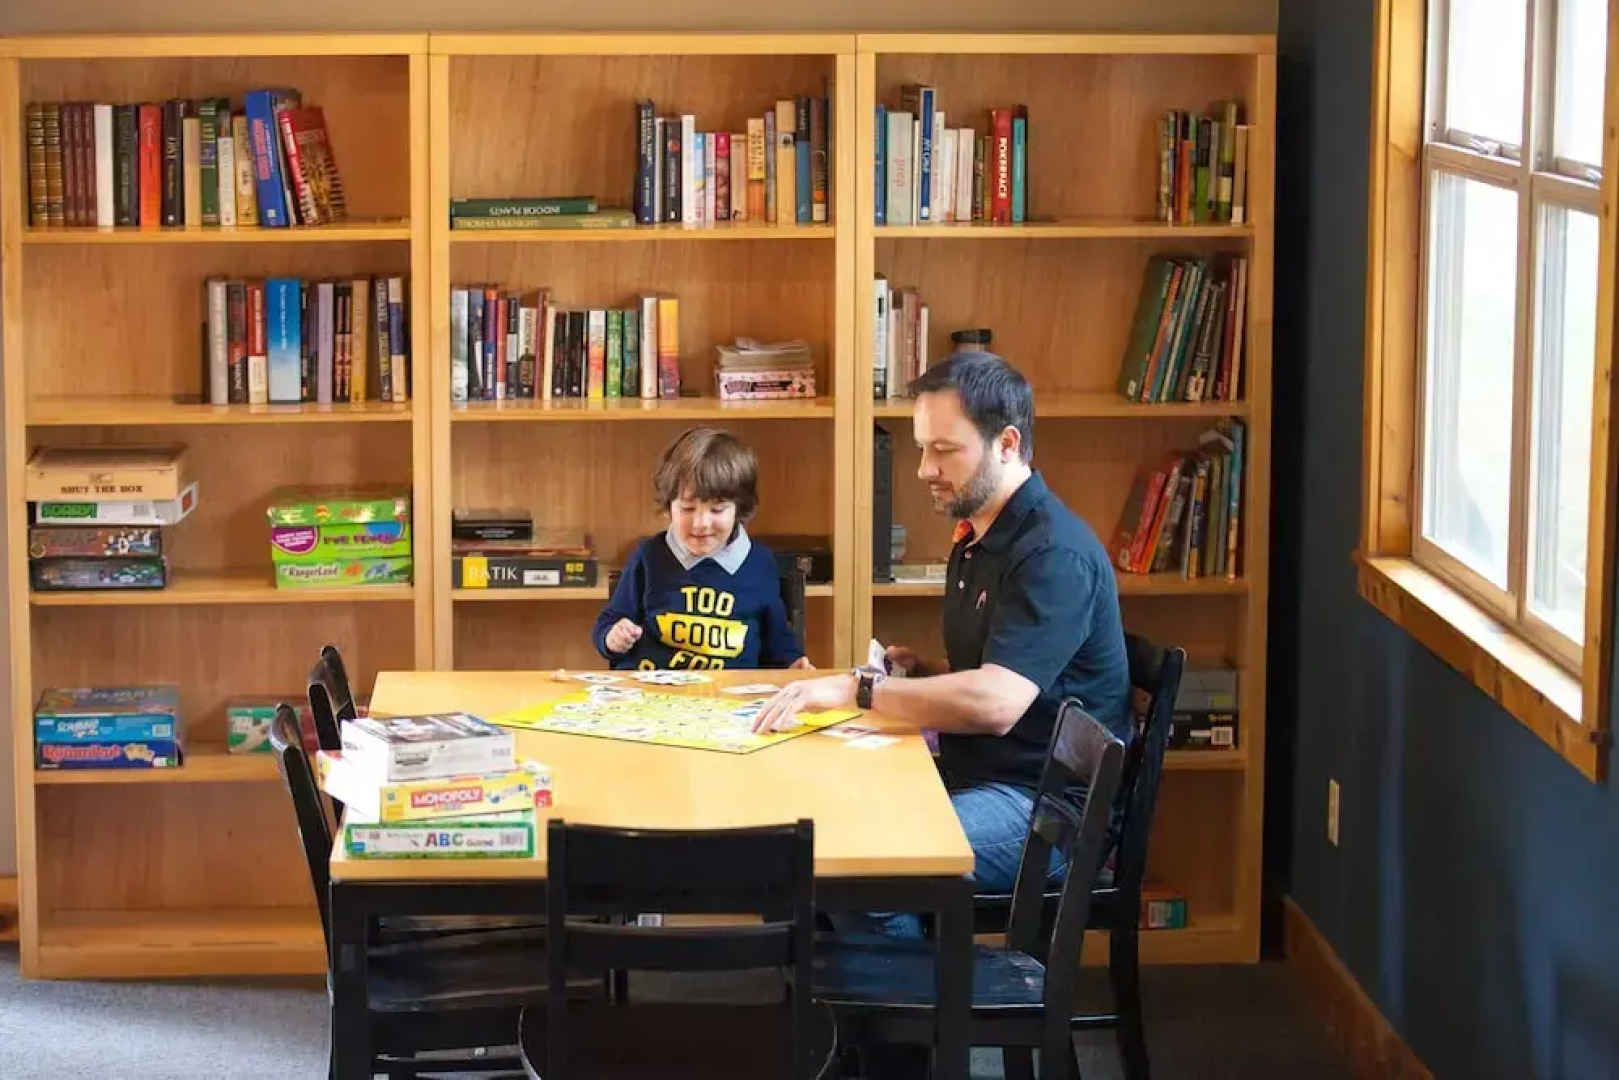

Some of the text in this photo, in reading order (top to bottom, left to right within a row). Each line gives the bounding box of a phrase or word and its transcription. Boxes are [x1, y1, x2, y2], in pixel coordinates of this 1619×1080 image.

[998, 137, 1008, 199] POKERFACE
[60, 485, 144, 494] SHUT THE BOX
[469, 566, 518, 580] BATIK
[680, 585, 735, 617] TOO
[671, 621, 738, 650] COOL
[413, 788, 481, 807] MONOPOLY
[425, 833, 464, 848] ABC
